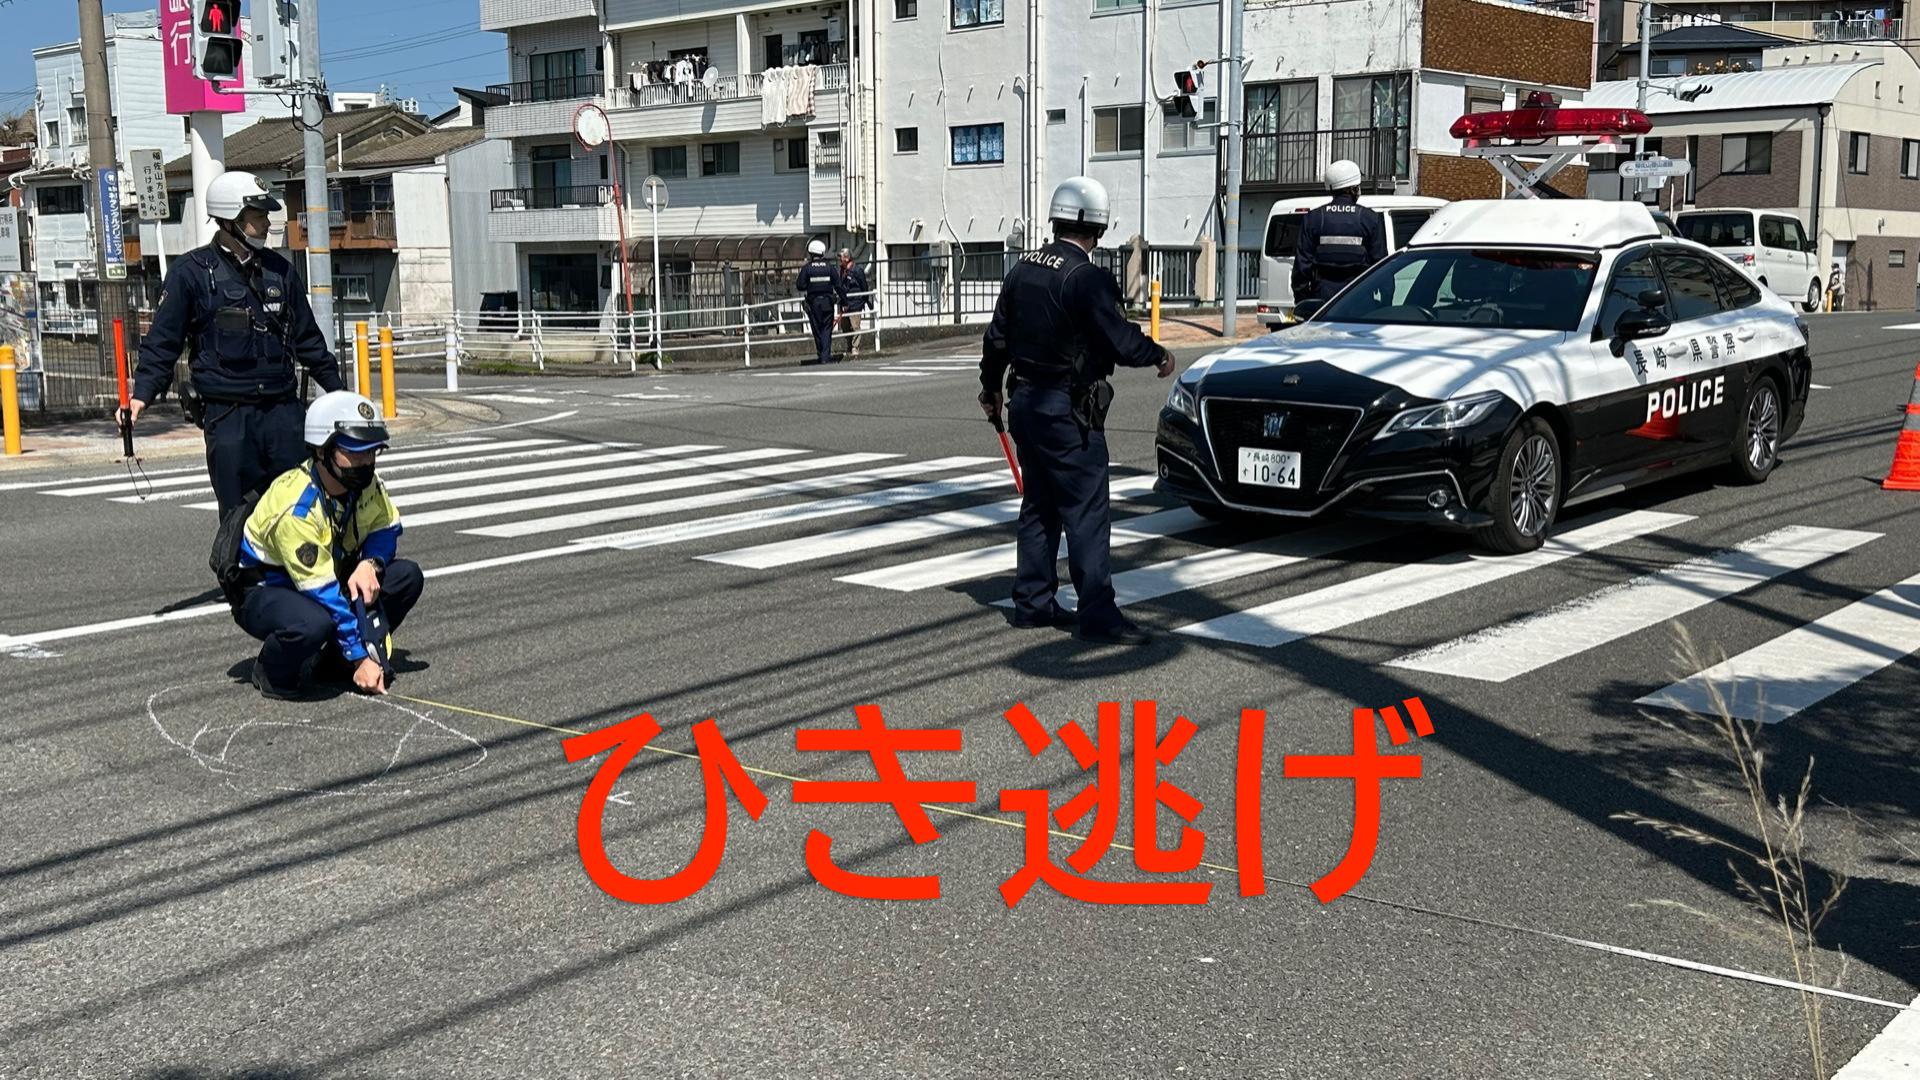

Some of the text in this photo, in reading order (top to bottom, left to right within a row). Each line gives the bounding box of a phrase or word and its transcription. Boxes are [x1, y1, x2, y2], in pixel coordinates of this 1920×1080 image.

[169, 0, 192, 66] 行
[1326, 205, 1356, 213] POLICE
[1633, 333, 1736, 375] 長崎県警察
[1646, 375, 1725, 423] POLICE
[1254, 463, 1296, 485] 10-64
